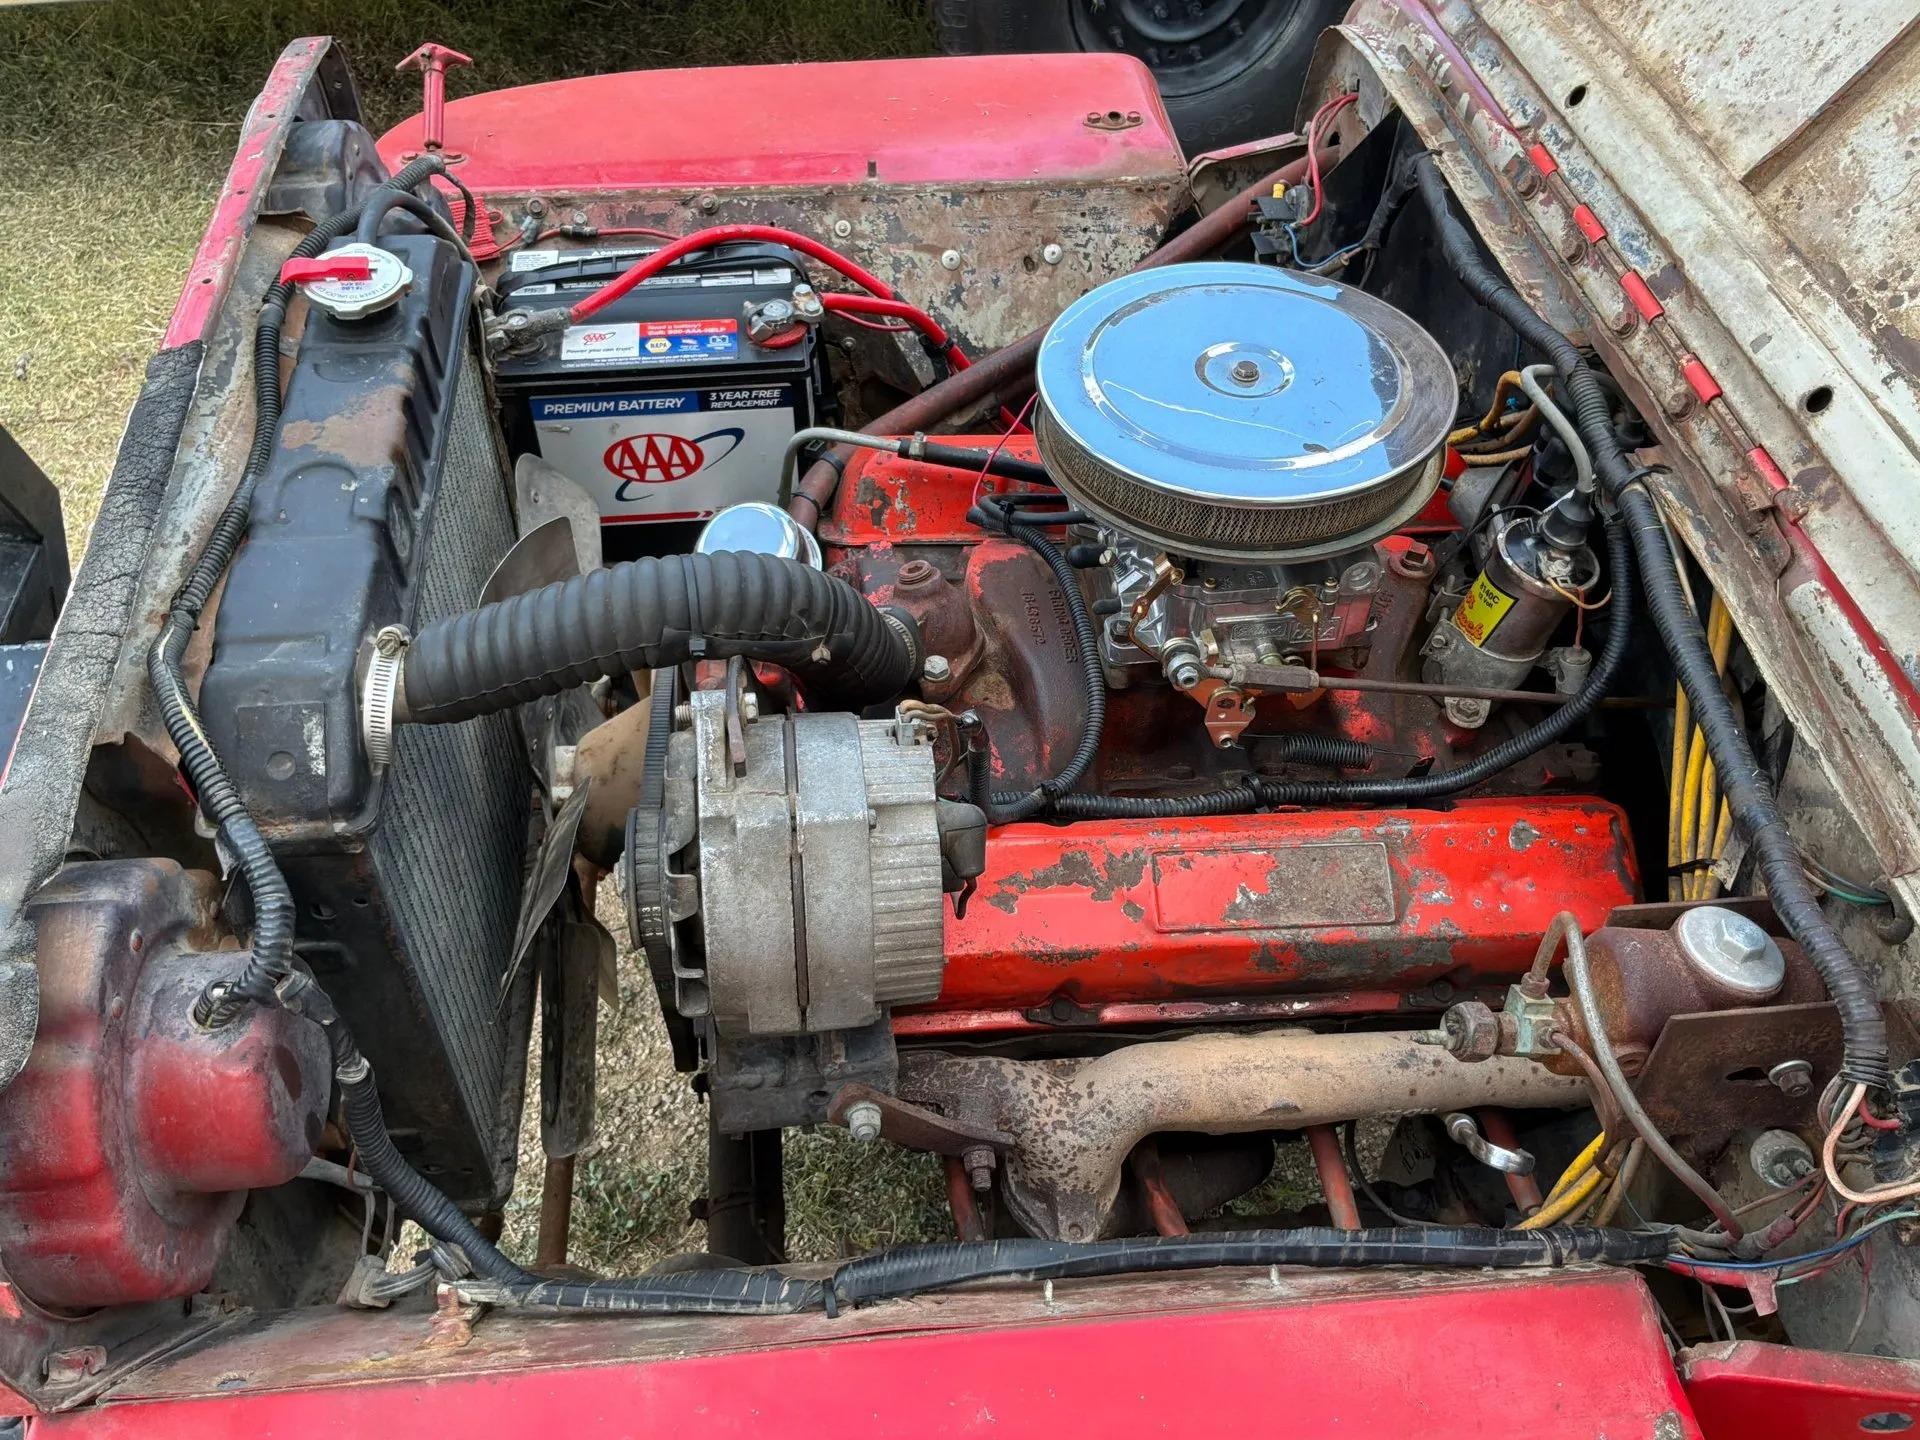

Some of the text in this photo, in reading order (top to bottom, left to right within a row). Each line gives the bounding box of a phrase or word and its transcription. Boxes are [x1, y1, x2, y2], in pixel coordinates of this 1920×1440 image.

[710, 388, 782, 401] 3 YEAR FREE
[544, 396, 686, 415] PREMIUM BATTERY
[710, 398, 780, 410] REPLACEMENT
[612, 434, 698, 482] AAA
